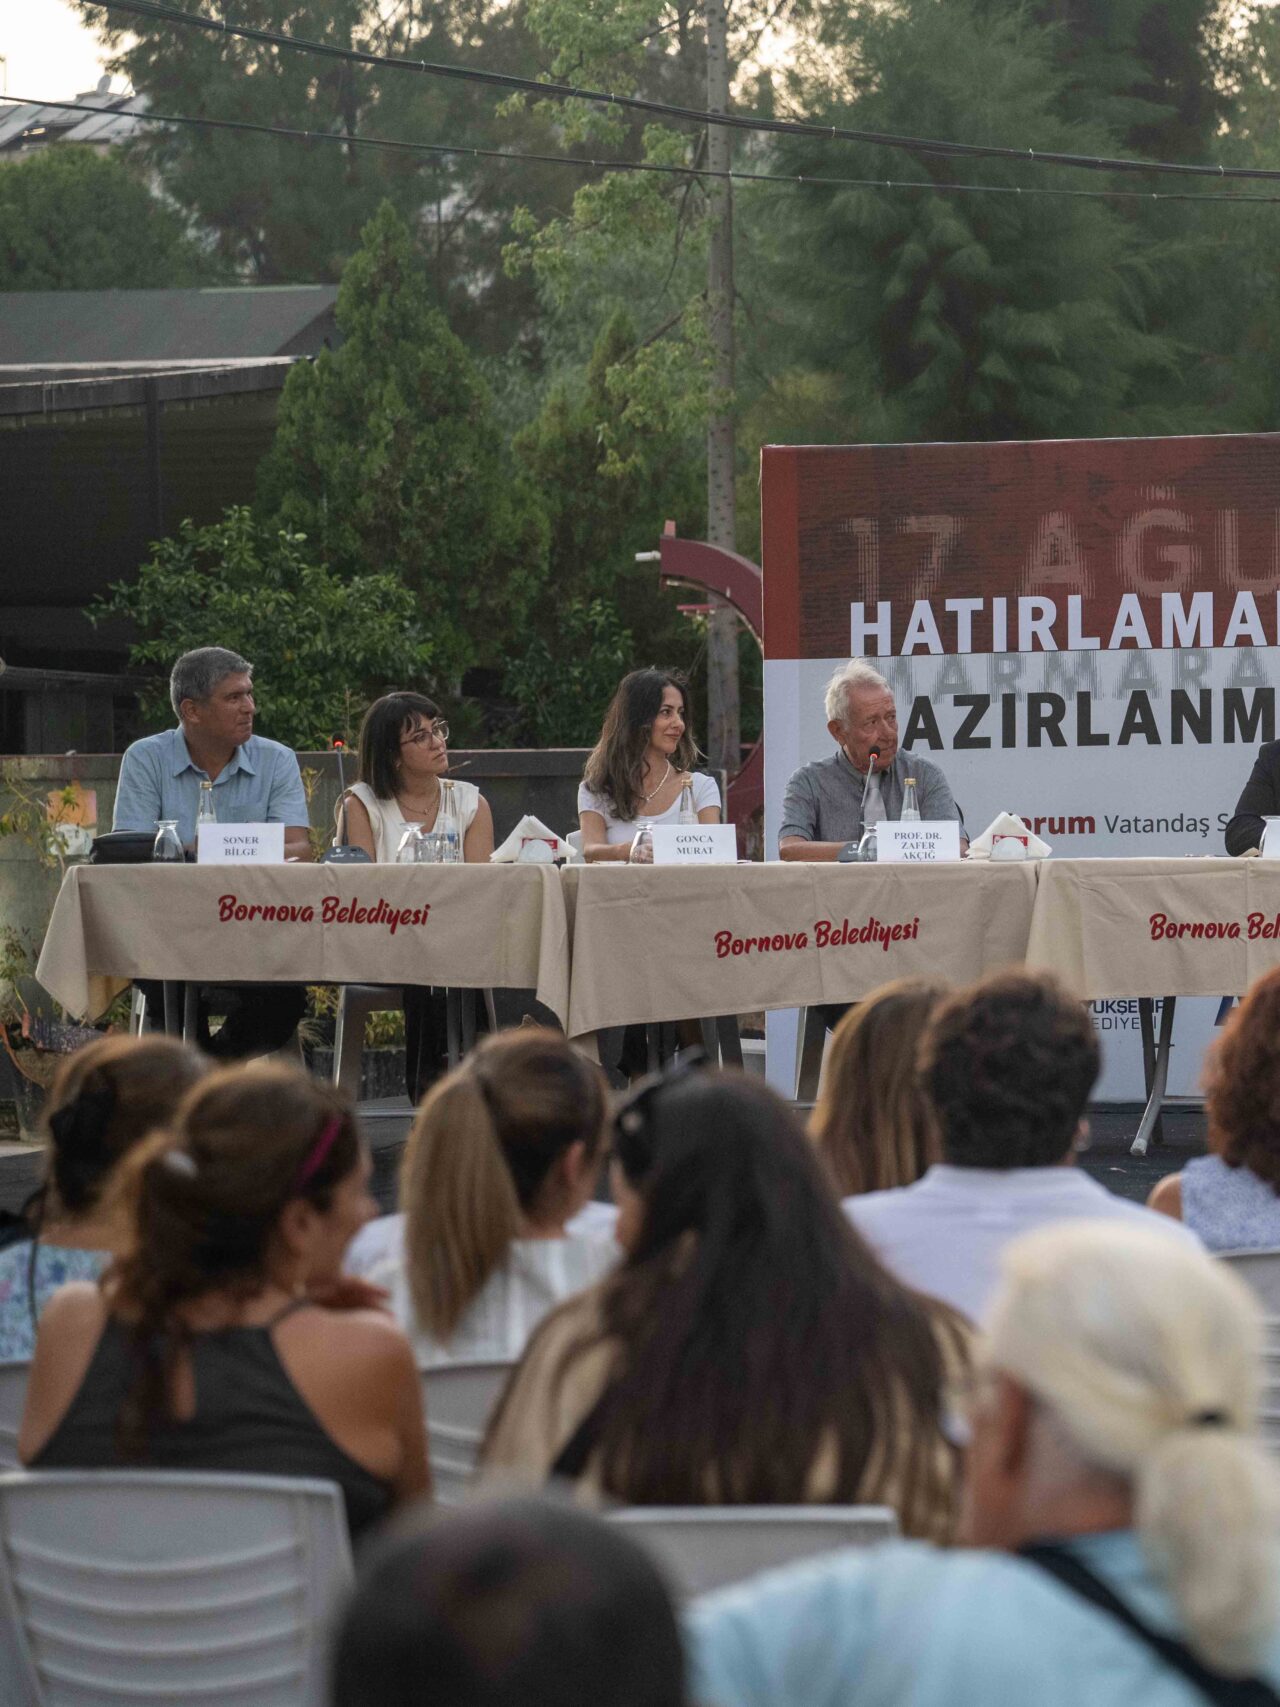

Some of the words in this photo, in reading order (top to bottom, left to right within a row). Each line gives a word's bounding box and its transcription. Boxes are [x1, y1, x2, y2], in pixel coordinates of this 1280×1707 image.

[840, 513, 968, 605] 17
[1020, 814, 1096, 835] rum
[1104, 813, 1210, 838] Vatandaş
[223, 836, 259, 846] SONER
[676, 834, 714, 845] GONCA
[894, 832, 923, 841] PROF.
[925, 832, 943, 841] DR.
[676, 846, 715, 856] MURAT
[901, 841, 935, 850] ZAFER
[224, 846, 258, 857] BİLGE
[902, 849, 936, 861] AKÇIĞ
[218, 894, 314, 922] Bornova
[321, 896, 431, 935] Belediyesi
[1149, 912, 1241, 941] Bornova
[714, 930, 808, 958] Bornova
[814, 917, 920, 951] Belediyesi
